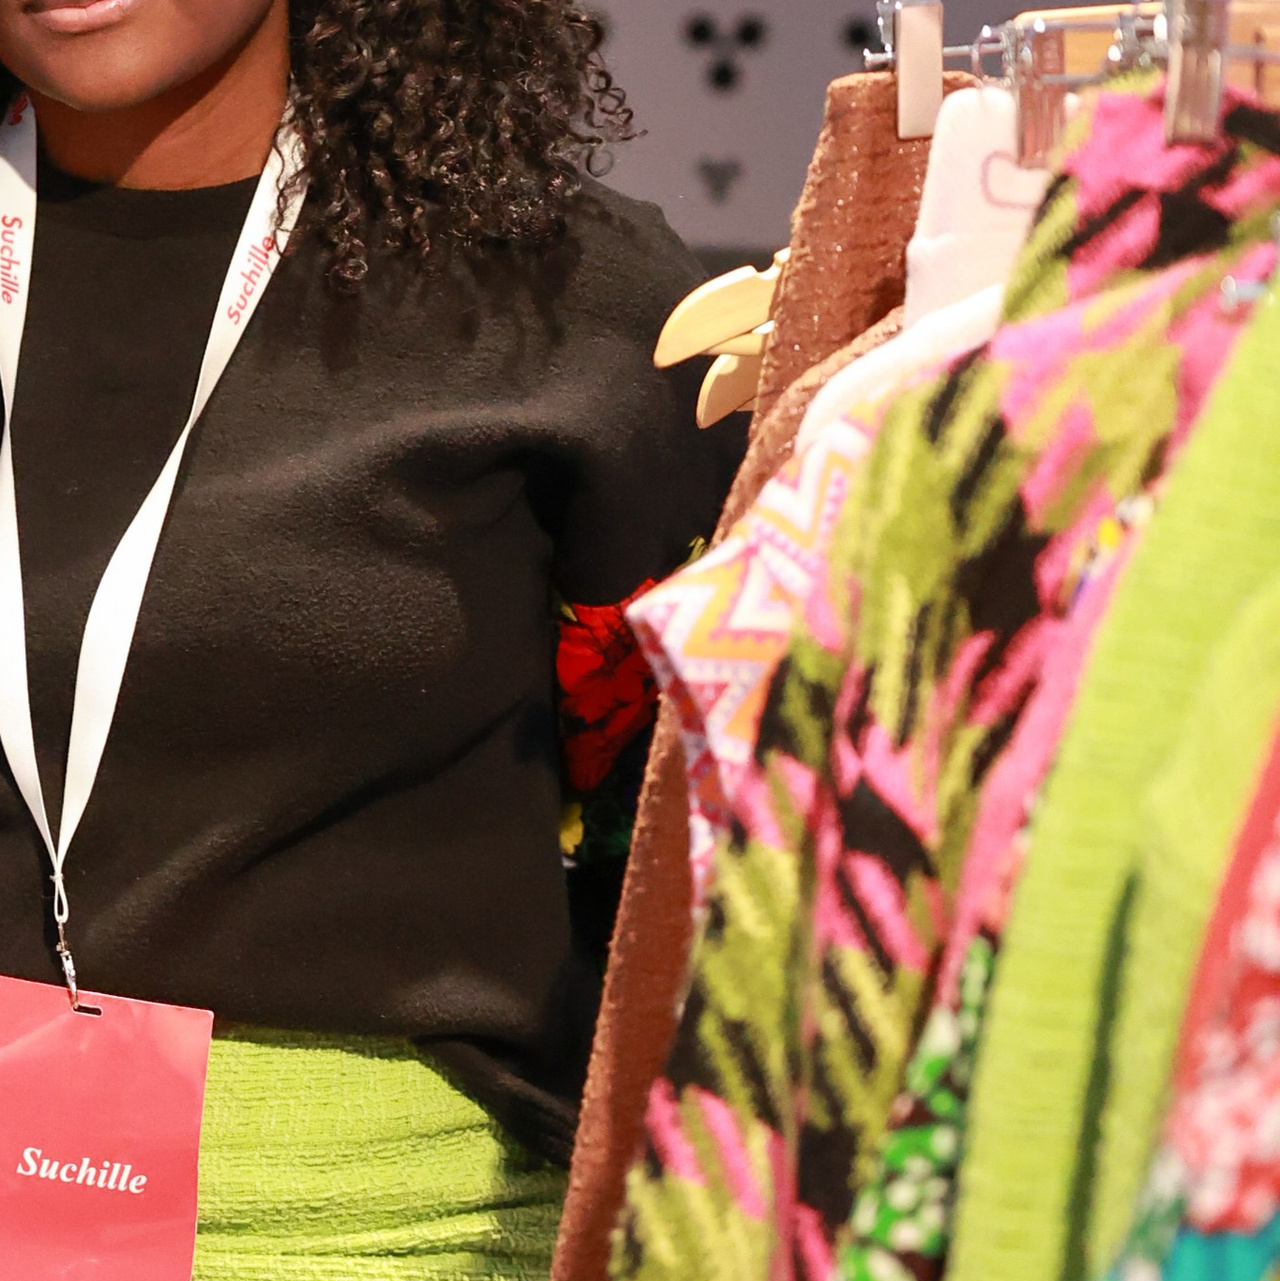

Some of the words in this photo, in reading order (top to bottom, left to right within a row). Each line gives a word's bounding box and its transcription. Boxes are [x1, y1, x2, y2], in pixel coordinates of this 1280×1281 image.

[0, 214, 23, 305] Suchille
[227, 235, 275, 325] Suchille
[17, 1146, 148, 1195] Suchille
